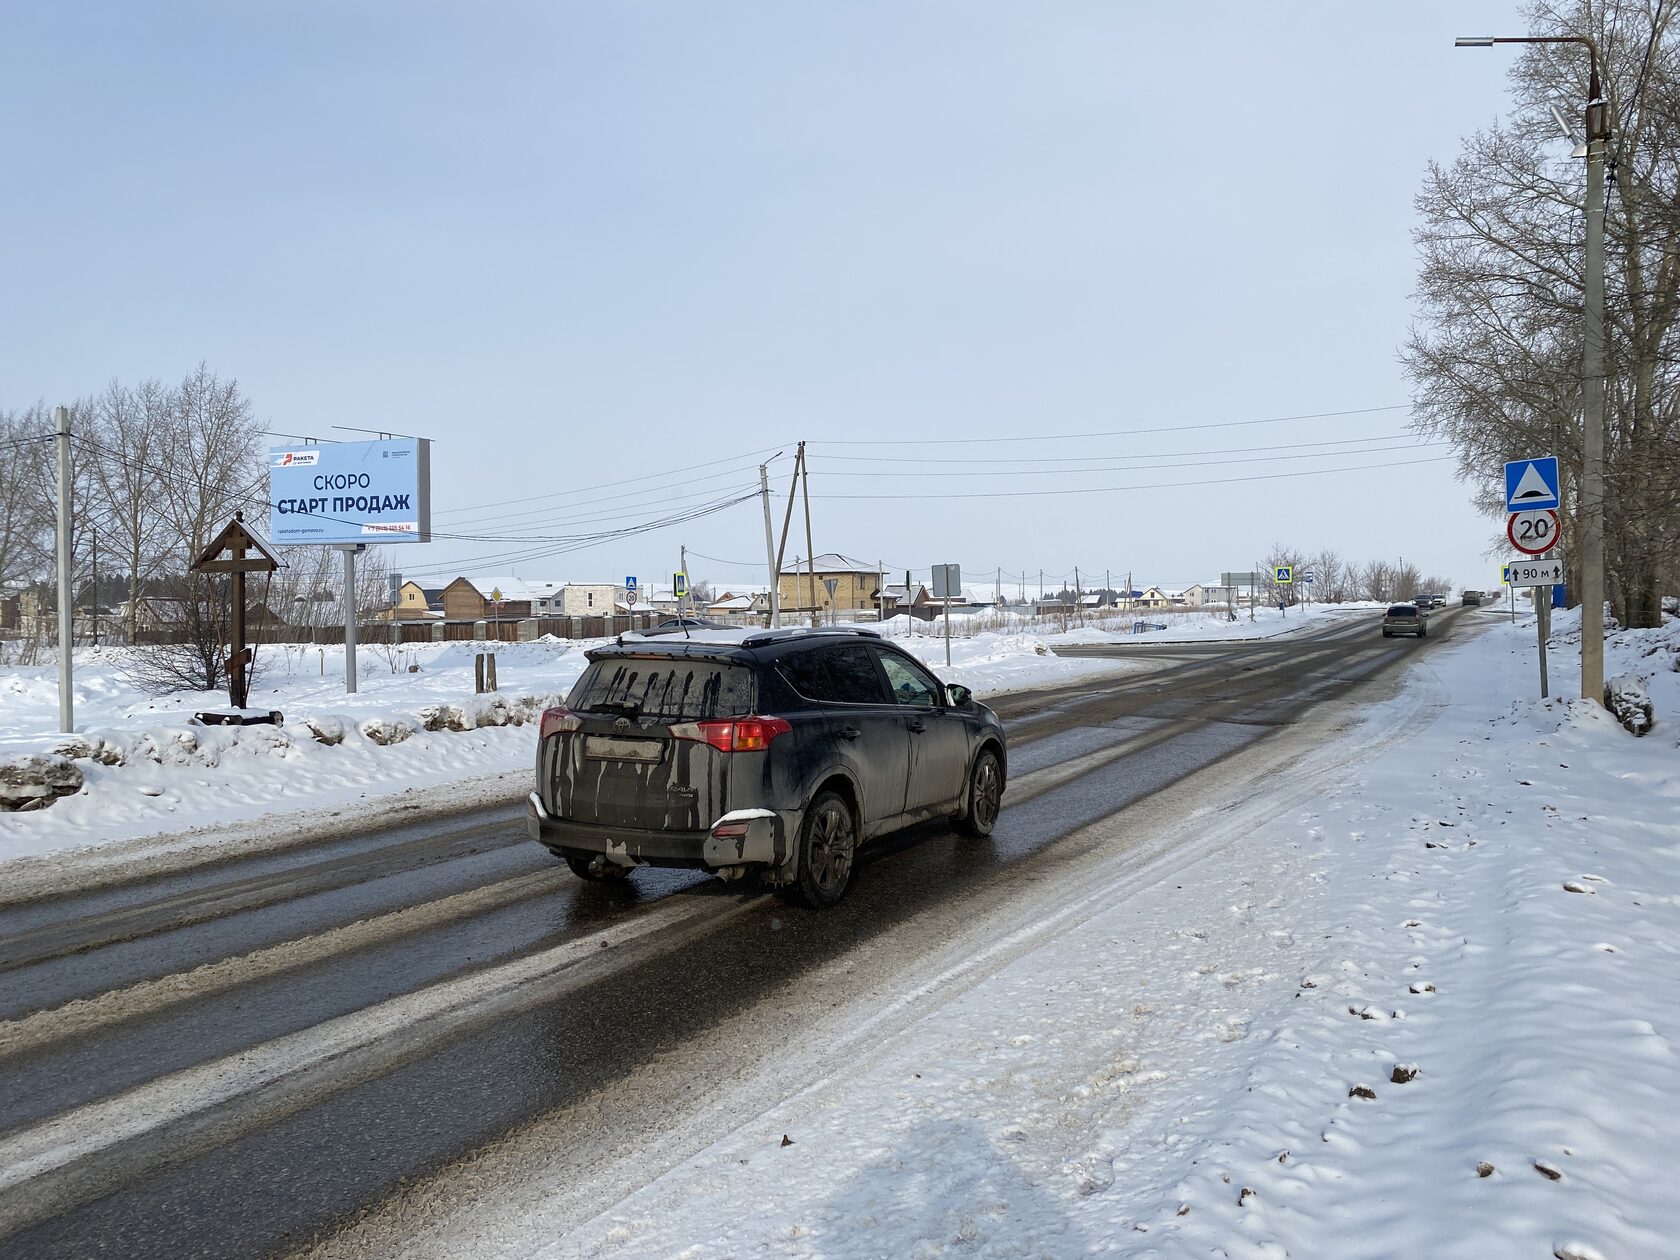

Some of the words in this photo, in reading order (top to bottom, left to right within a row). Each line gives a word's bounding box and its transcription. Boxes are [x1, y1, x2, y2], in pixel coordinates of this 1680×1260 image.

[313, 473, 370, 490] СКОРО
[277, 497, 329, 514] СТАРТ
[332, 494, 411, 514] ПРОДАЖ
[1520, 518, 1549, 540] 20
[1523, 568, 1538, 579] 90
